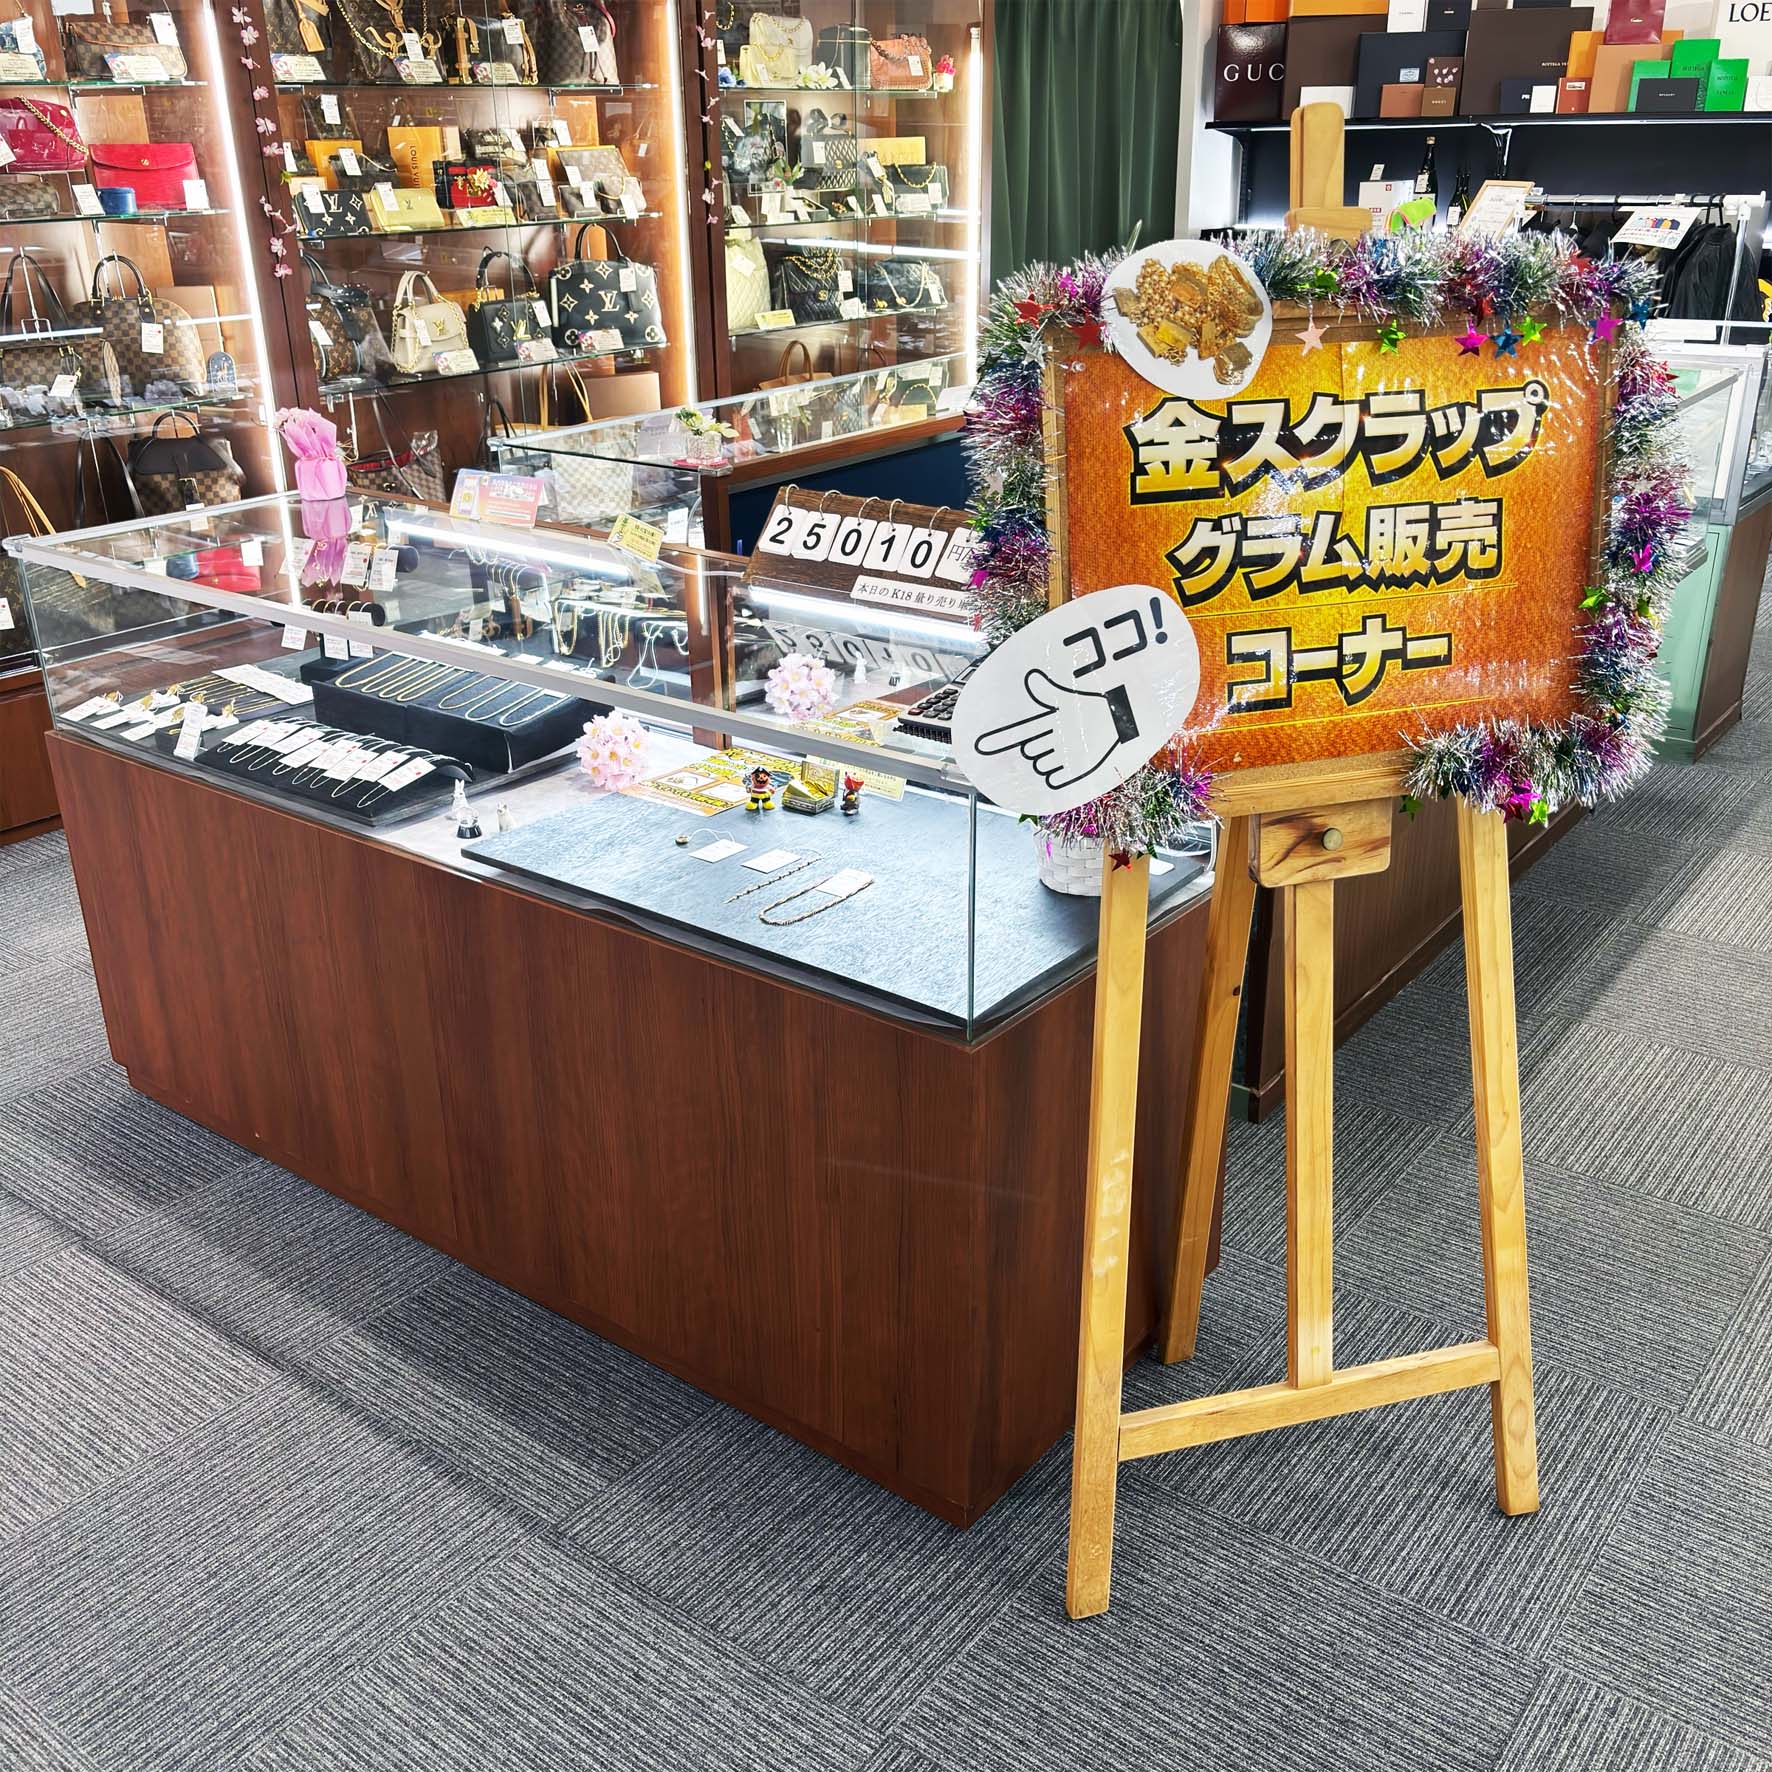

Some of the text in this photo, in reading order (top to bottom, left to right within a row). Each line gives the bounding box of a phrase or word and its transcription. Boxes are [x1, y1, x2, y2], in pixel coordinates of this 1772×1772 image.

[1127, 379, 1549, 505] 金スクラップ
[768, 516, 934, 570] 25010
[1167, 497, 1503, 607] グラム販売
[1226, 613, 1453, 715] コーナー
